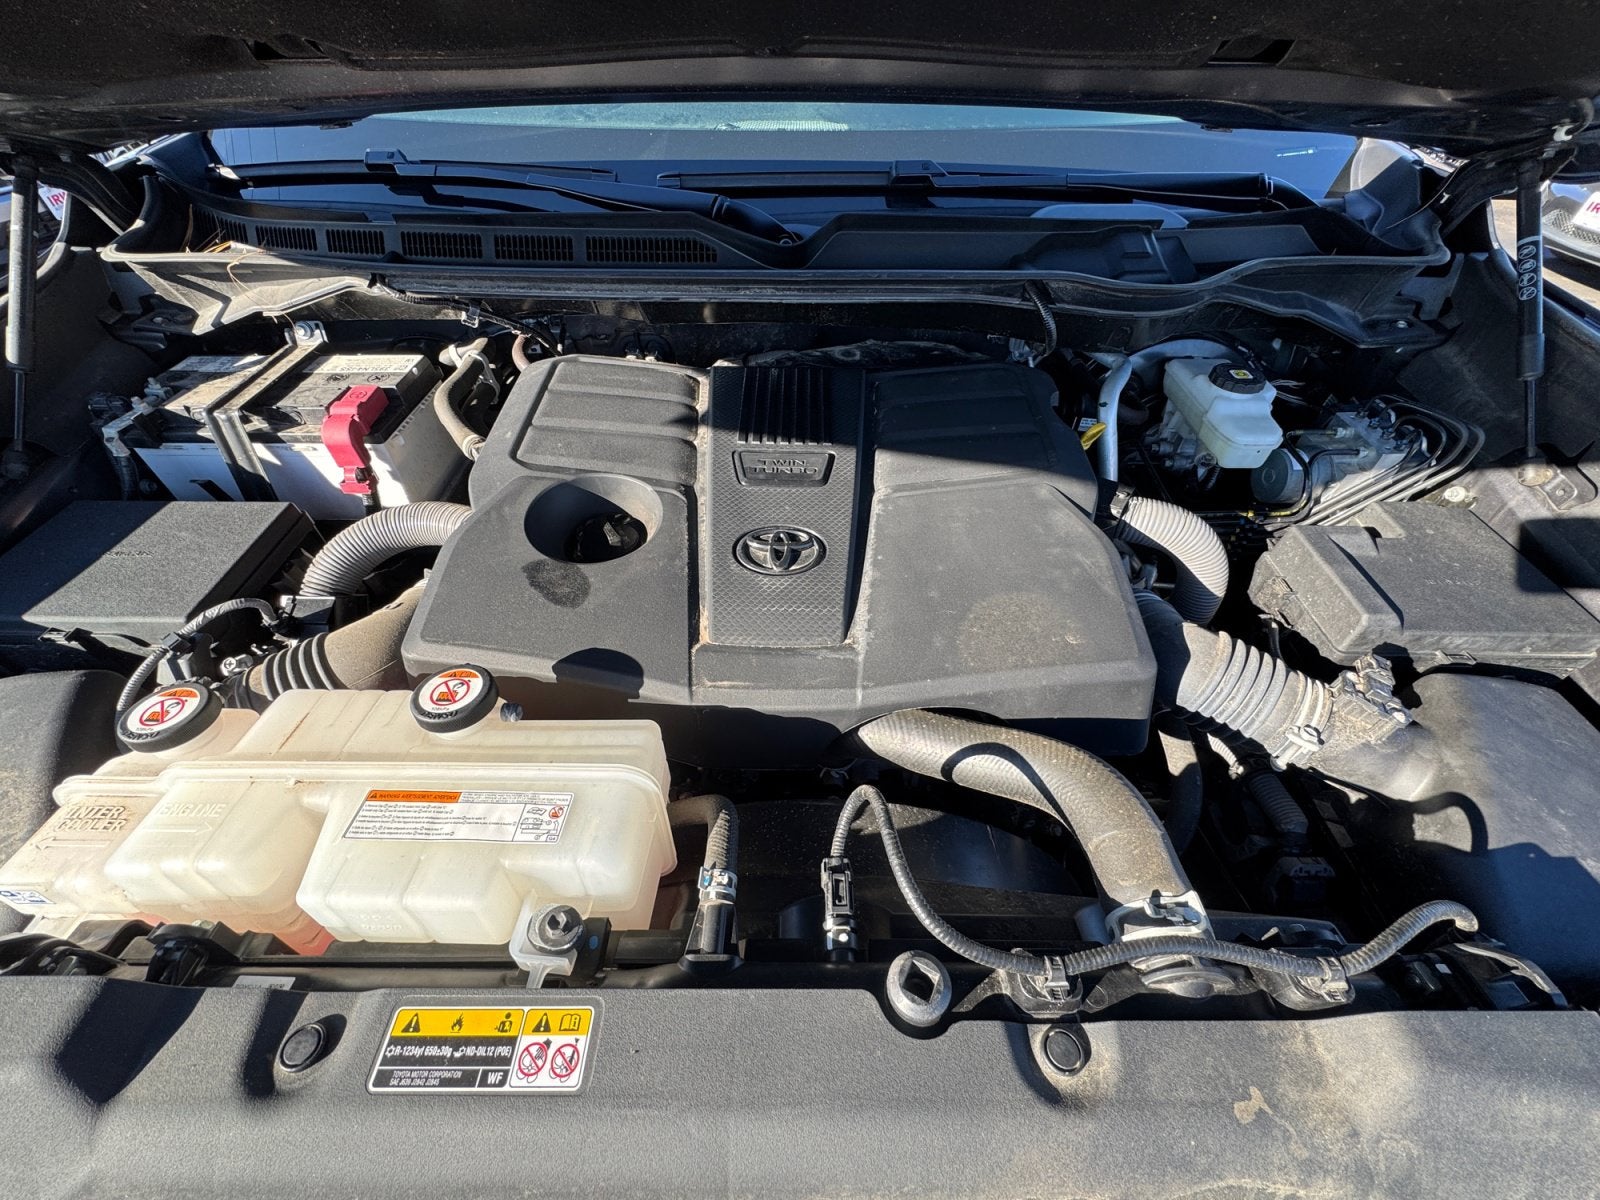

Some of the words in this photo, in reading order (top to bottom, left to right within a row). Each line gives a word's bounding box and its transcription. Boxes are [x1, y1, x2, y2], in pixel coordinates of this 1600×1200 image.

[744, 466, 819, 474] TURBO
[758, 459, 807, 467] TWIN
[65, 806, 126, 820] INTER
[154, 803, 227, 818] ENGINE
[54, 818, 127, 833] COOLER
[394, 1045, 425, 1058] R-1234yf
[424, 1045, 453, 1058] 650±30g
[494, 1045, 512, 1059] (POE)
[393, 1070, 411, 1078] TOYOTA
[411, 1070, 429, 1078] MOTOR
[428, 1070, 463, 1079] CORPORATION
[487, 1071, 504, 1085] WF
[389, 1078, 401, 1086] SAE
